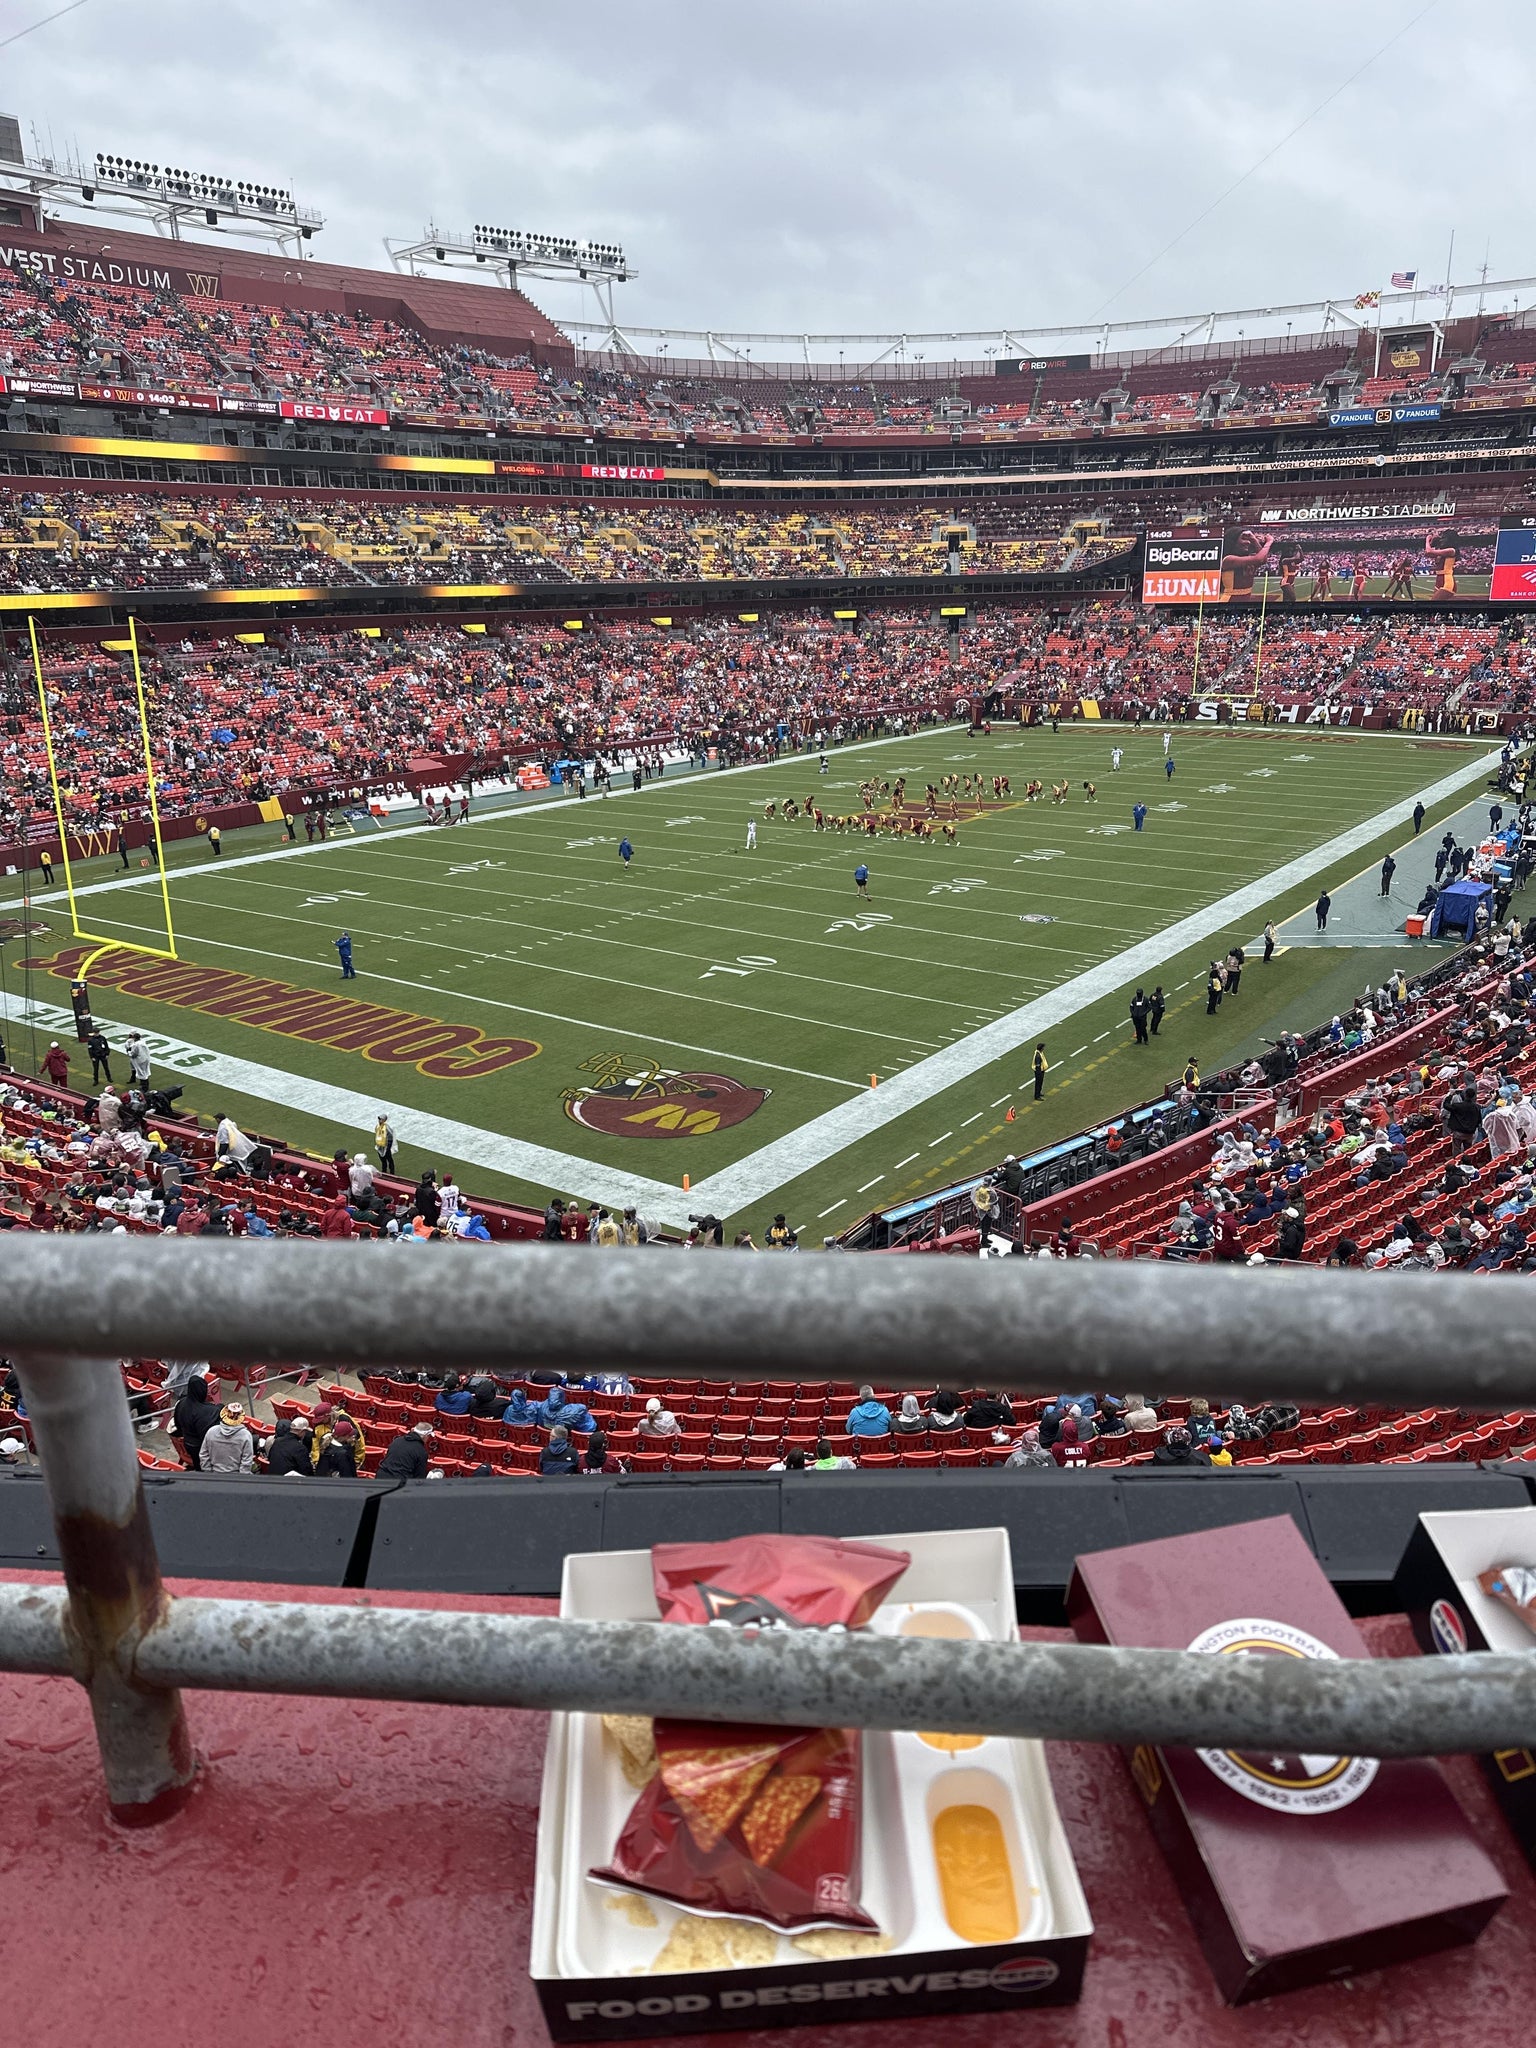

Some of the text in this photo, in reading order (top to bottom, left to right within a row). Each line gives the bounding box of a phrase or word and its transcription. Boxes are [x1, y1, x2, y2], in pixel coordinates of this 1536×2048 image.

[63, 257, 171, 290] STADIUM
[1030, 360, 1067, 369] REDWIRE
[31, 382, 75, 392] NORTHWEST
[103, 389, 112, 399] 0
[136, 392, 145, 401] 0
[149, 393, 175, 404] 14:03
[344, 409, 374, 422] CAT
[1340, 413, 1373, 423] FANDUEL
[1378, 411, 1390, 421] 25
[1406, 408, 1439, 418] FANDUEL
[501, 465, 535, 473] WELCOME
[1270, 461, 1305, 470] WORLD
[1308, 458, 1369, 468] CHAMPIONS
[630, 468, 654, 479] CAT
[1286, 506, 1379, 520] NORTHWEST
[1382, 502, 1456, 516] STADIUM
[1148, 546, 1219, 565] BigBear.ai
[1145, 578, 1219, 597] LiUNA!
[932, 877, 988, 894] 30
[831, 911, 894, 932] 20
[708, 954, 778, 977] 10
[12, 944, 543, 1080] COMMANDERS
[121, 1139, 140, 1153] 52
[446, 1196, 455, 1208] 17
[448, 1221, 459, 1234] 76
[1057, 1246, 1067, 1260] 3
[605, 1384, 622, 1395] 14
[1064, 1447, 1083, 1456] COOLEY
[1251, 1625, 1324, 1659] FOOTBAL
[565, 1968, 993, 2021] FOOD DESERVES
